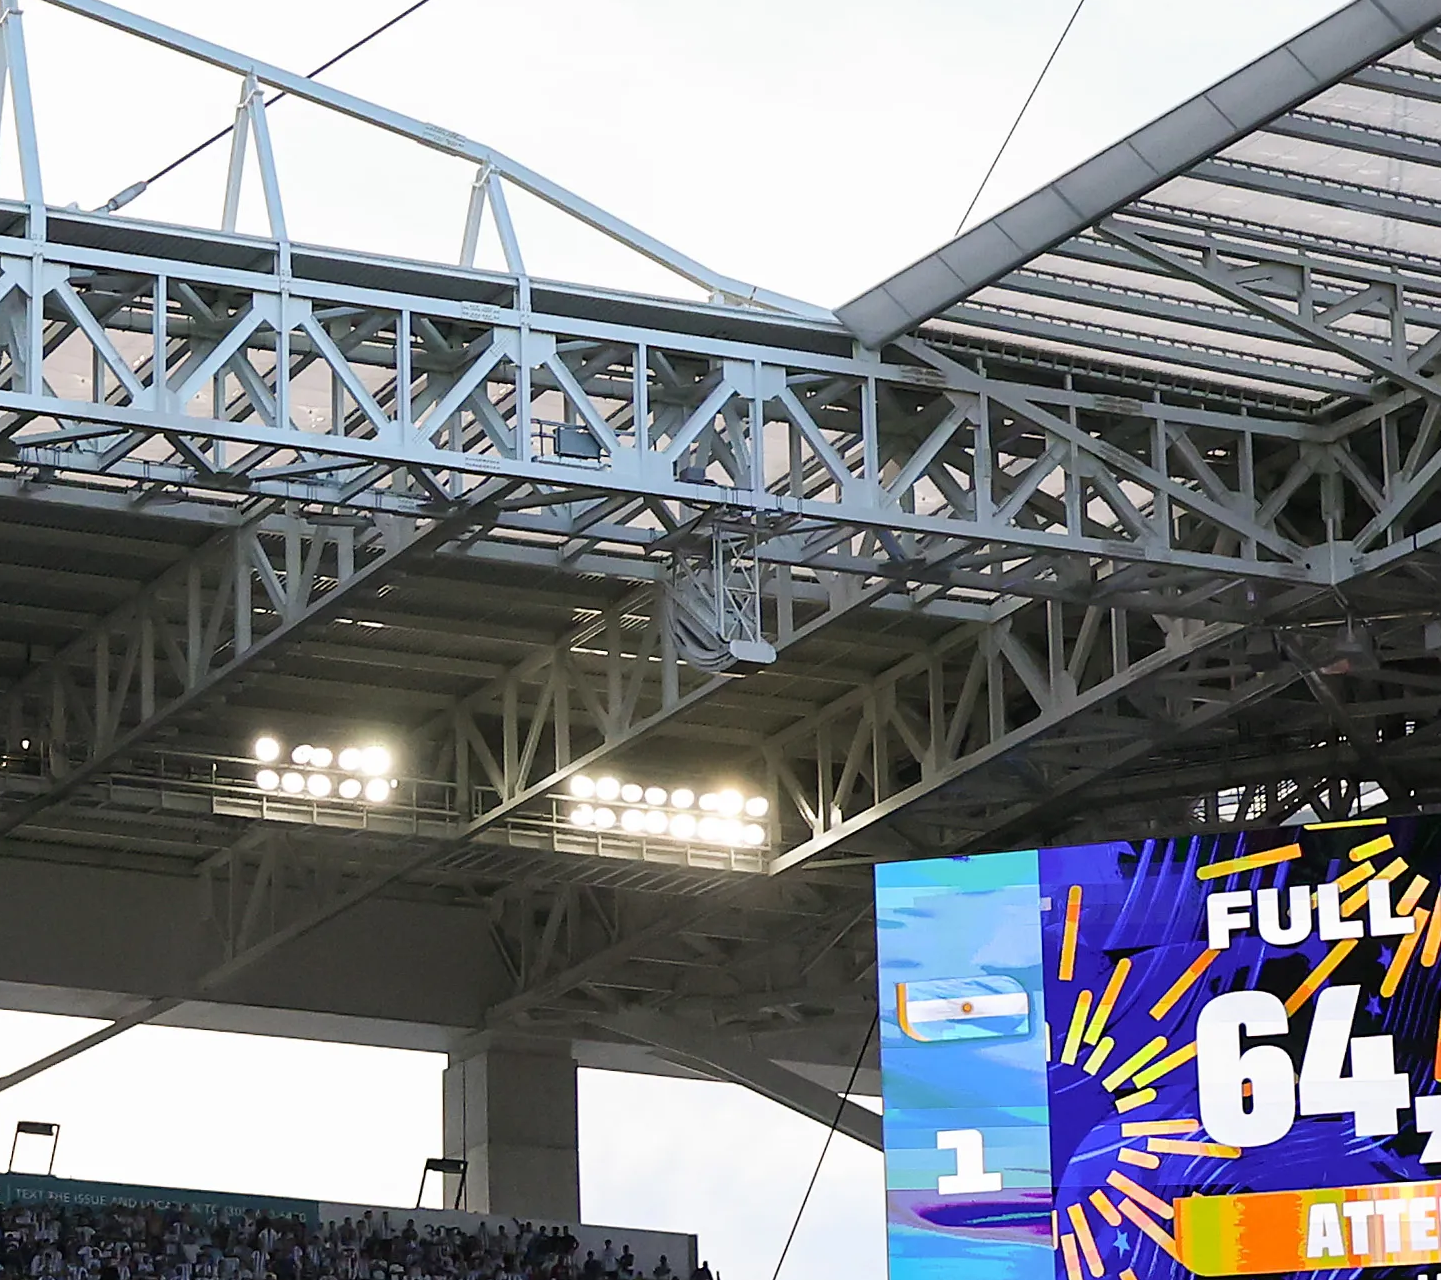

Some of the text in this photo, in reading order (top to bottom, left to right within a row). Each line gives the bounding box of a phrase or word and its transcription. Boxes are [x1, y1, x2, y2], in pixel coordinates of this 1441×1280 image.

[1207, 879, 1415, 950] FULL
[936, 1129, 1003, 1195] 1
[16, 1189, 43, 1200] TEXT
[74, 1193, 107, 1205] ISSUE
